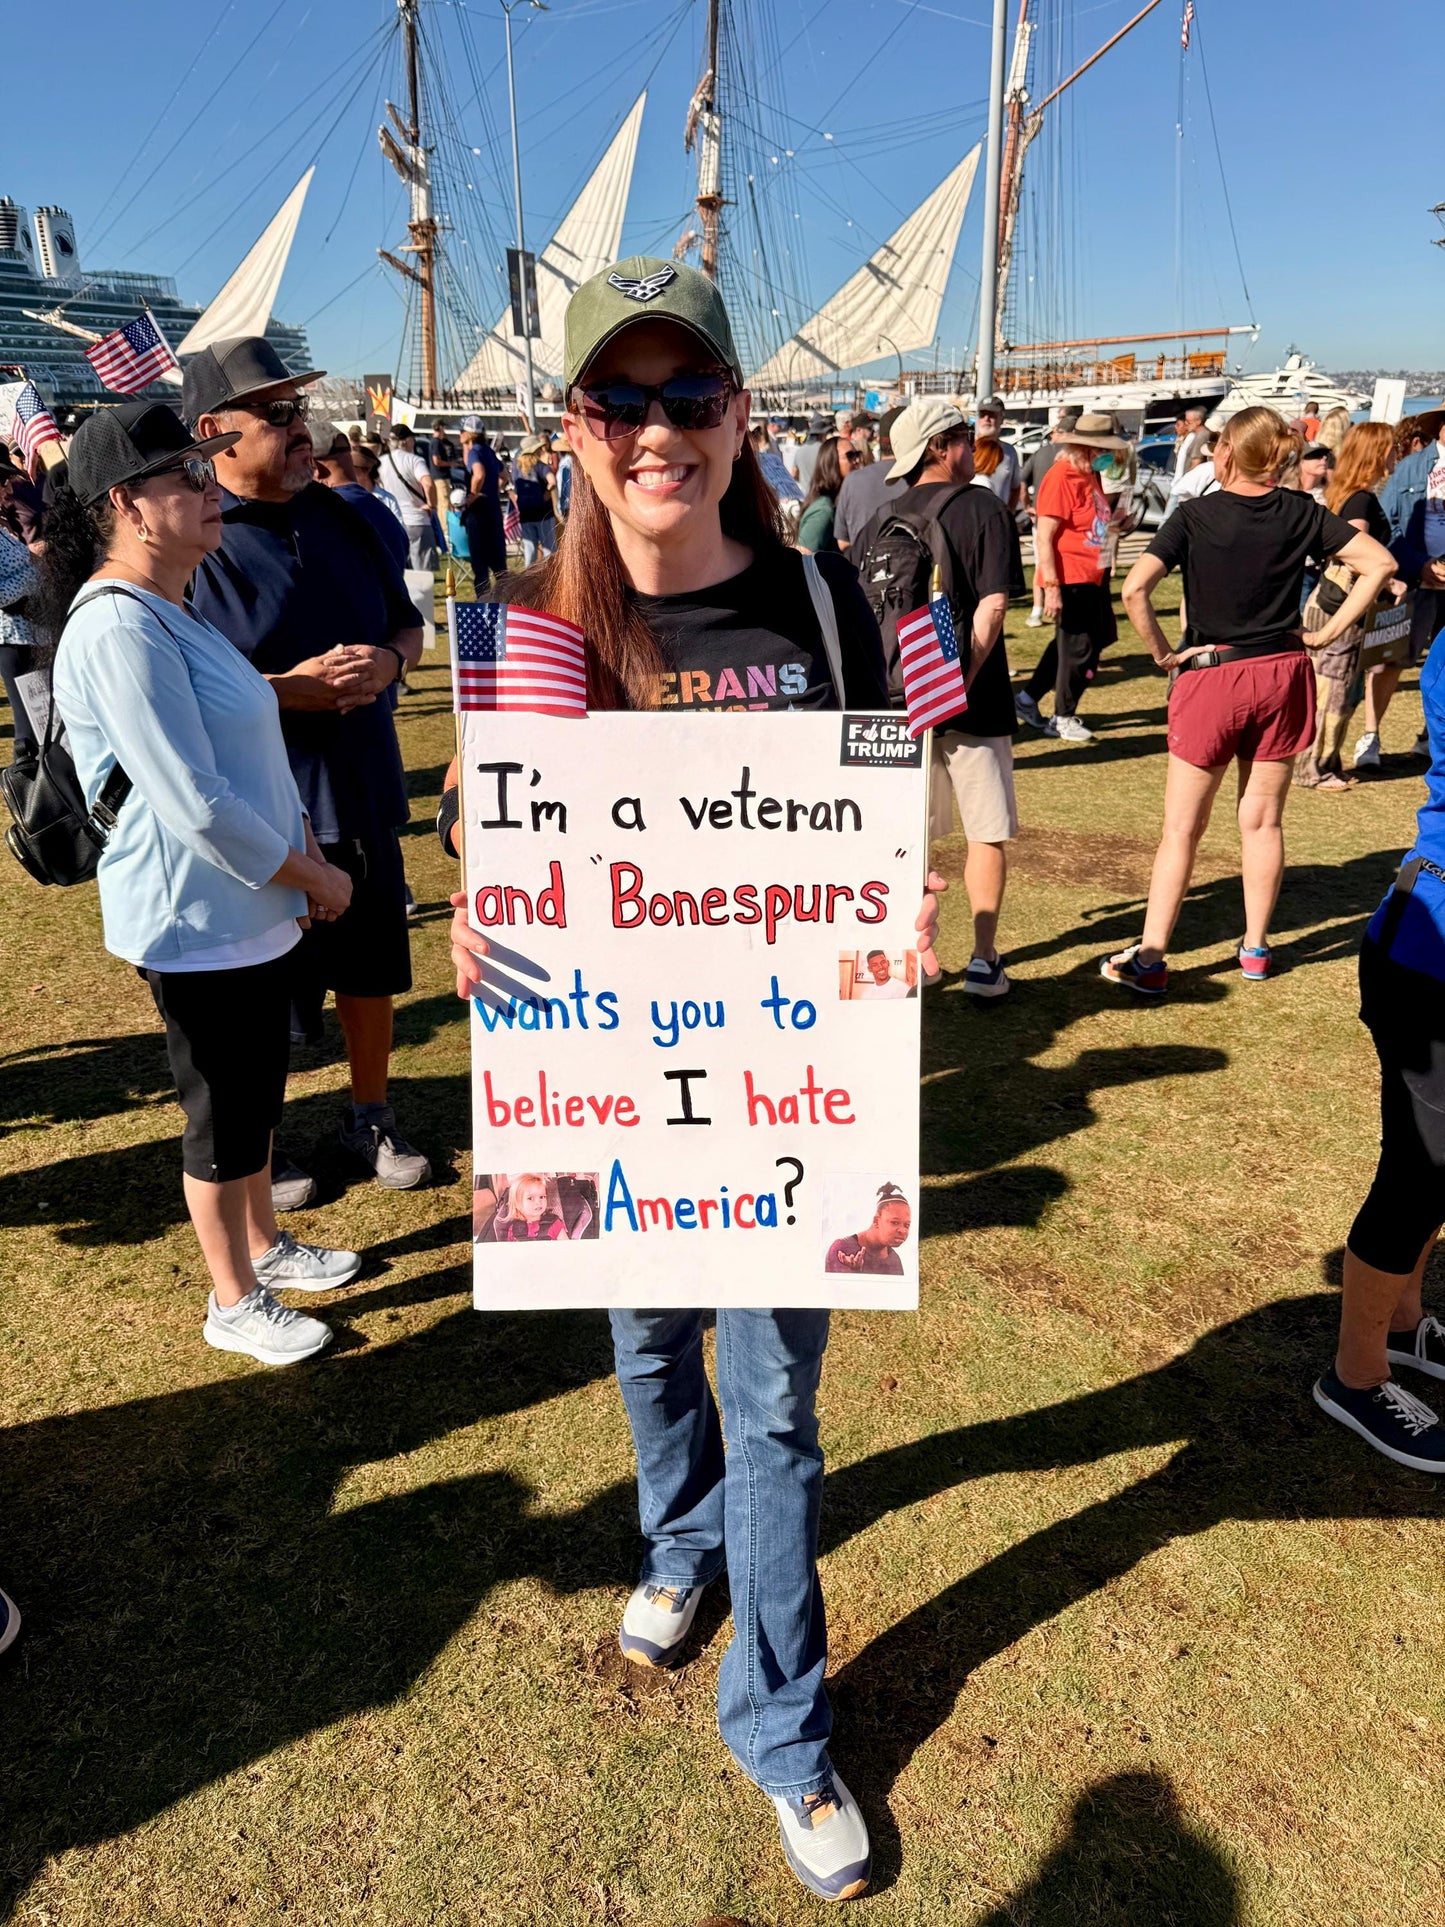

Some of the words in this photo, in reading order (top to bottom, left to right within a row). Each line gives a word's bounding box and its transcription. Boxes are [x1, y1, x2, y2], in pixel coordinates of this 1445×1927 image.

[649, 663, 808, 705] ERANS
[847, 741, 917, 758] TRUMP
[477, 761, 567, 833] I'm
[611, 796, 648, 832] a
[679, 765, 863, 833] veteran
[475, 861, 568, 930] and
[474, 968, 621, 1033] wants
[651, 999, 725, 1048] you
[760, 975, 818, 1031] to
[483, 1070, 641, 1128] believe
[664, 1069, 712, 1126] I
[744, 1065, 856, 1126] hate
[603, 1156, 805, 1233] America?
